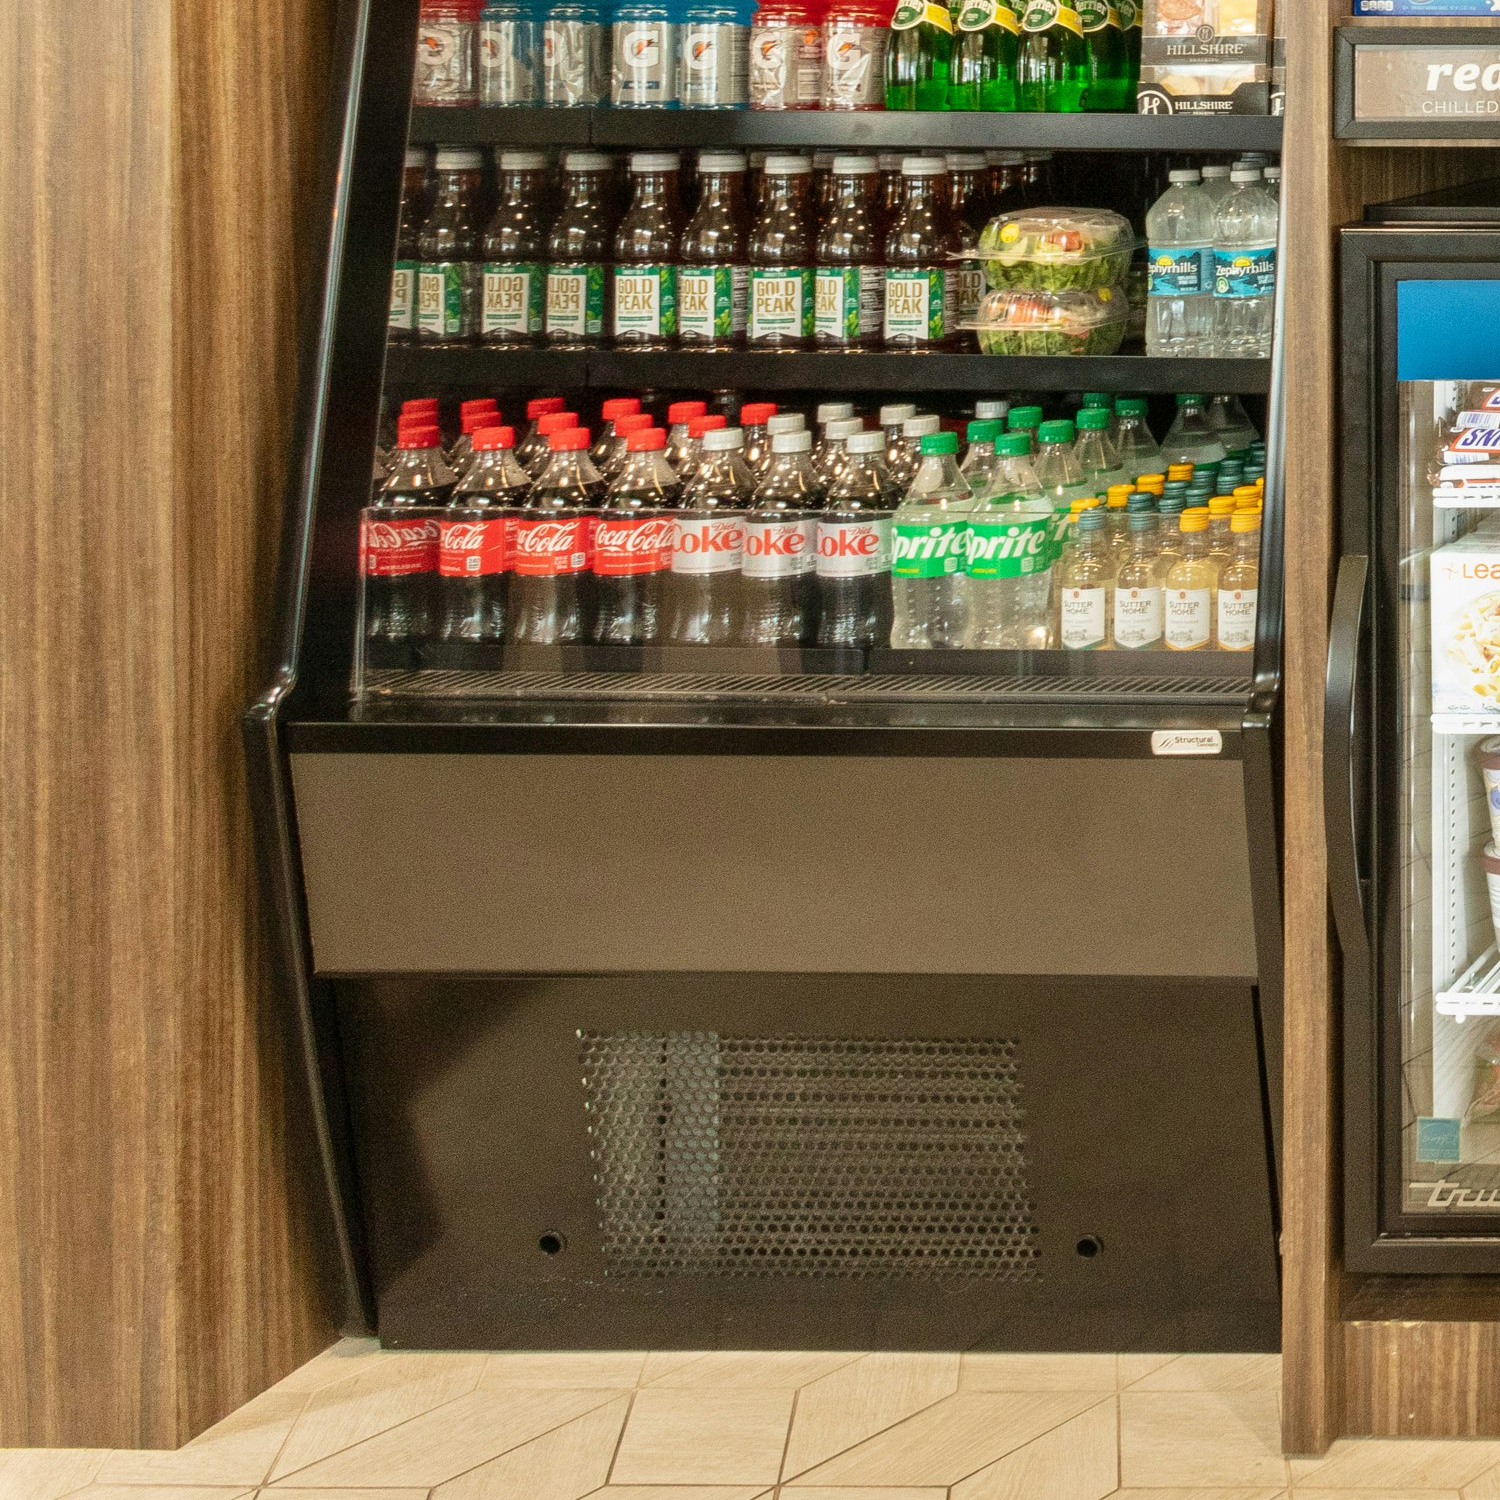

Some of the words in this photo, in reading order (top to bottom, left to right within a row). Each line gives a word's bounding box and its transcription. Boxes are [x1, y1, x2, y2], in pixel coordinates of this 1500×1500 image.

[1167, 44, 1243, 55] HILLSHIRE
[1175, 101, 1233, 110] HILLSHIRE
[1422, 100, 1498, 113] CHILLED
[1216, 262, 1274, 277] Zephyrhills
[618, 279, 653, 294] GOLD
[757, 281, 795, 296] GOLD
[889, 283, 923, 297] GOLD
[618, 295, 653, 310] PEAK
[757, 298, 796, 312] PEAK
[889, 299, 923, 313] PEAK
[1169, 601, 1199, 609] SUTTER
